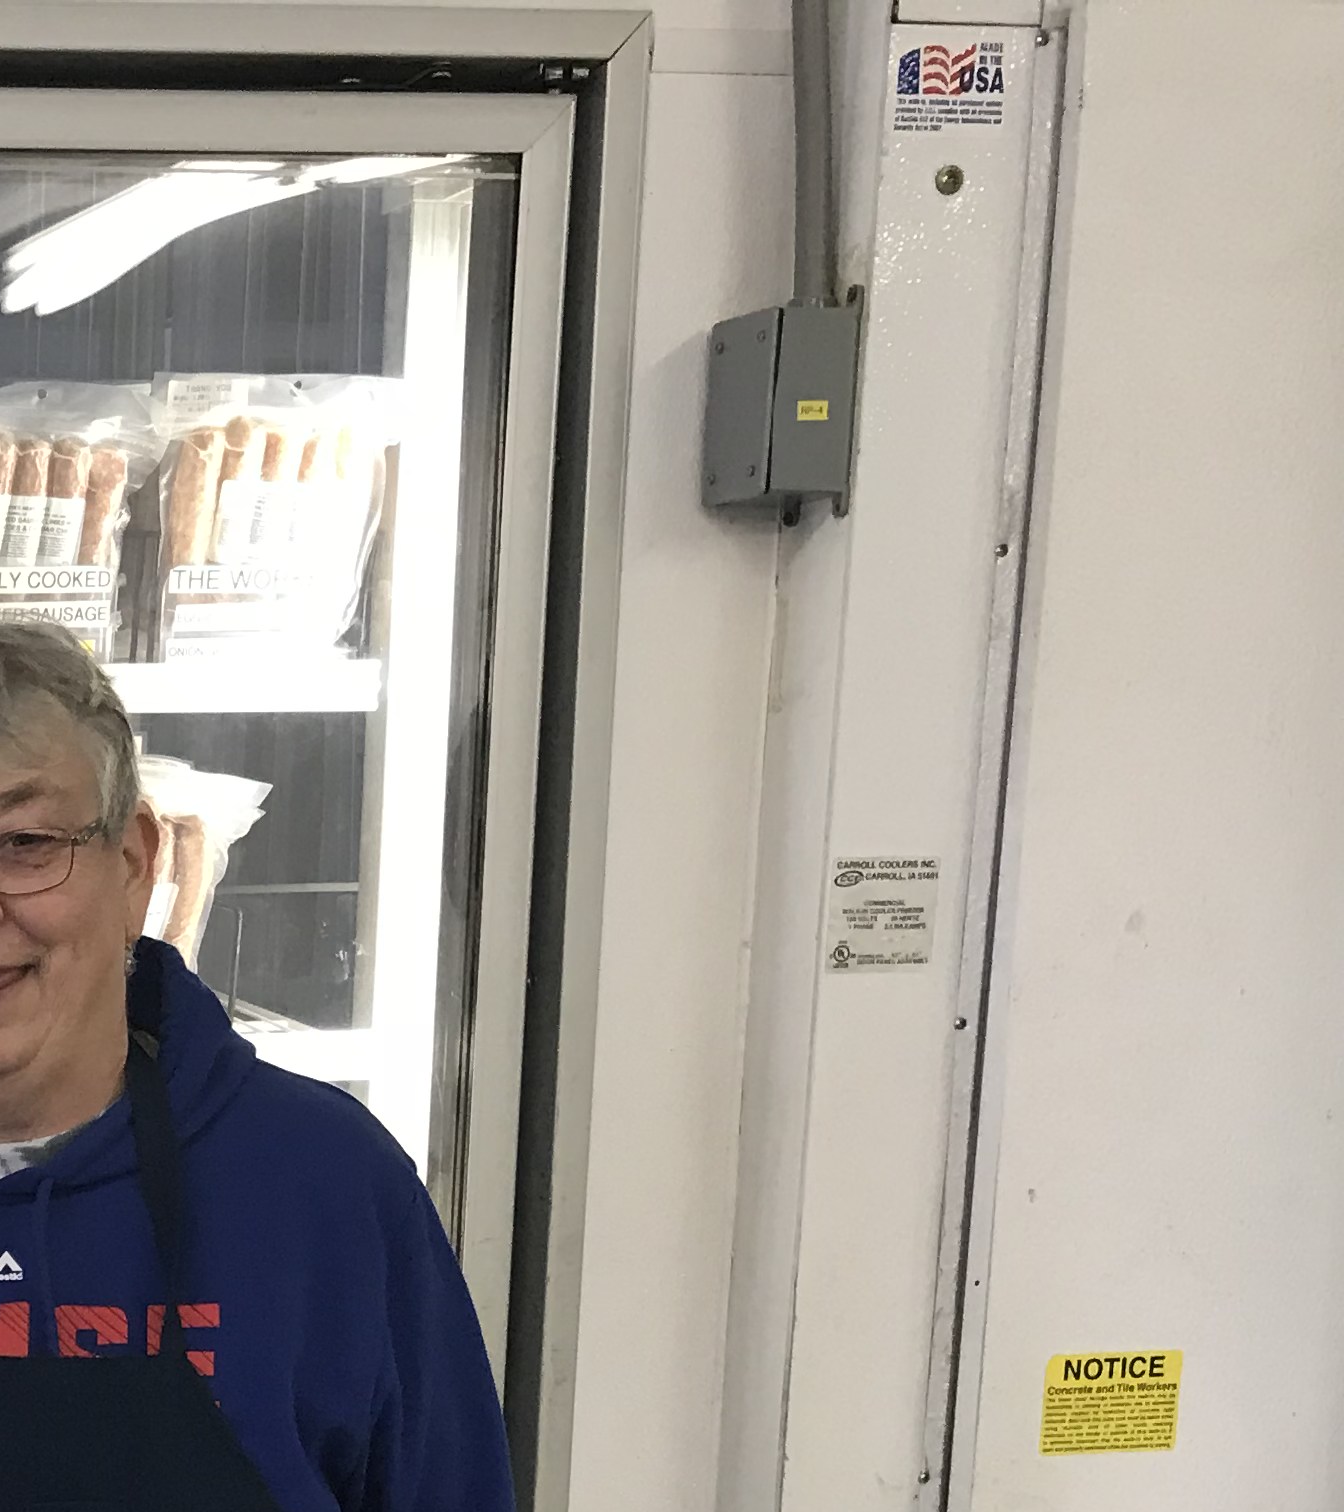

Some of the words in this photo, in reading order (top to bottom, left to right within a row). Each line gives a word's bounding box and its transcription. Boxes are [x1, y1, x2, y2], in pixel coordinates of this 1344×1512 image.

[960, 67, 1004, 94] USA
[27, 570, 111, 588] COOKED
[172, 570, 221, 590] THE
[30, 606, 108, 622] SAUSAGE
[837, 861, 876, 870] CARROLL
[878, 860, 919, 869] COOLERS
[908, 872, 916, 880] IA
[1063, 1356, 1166, 1380] NOTICE
[1047, 1386, 1093, 1396] Concrete
[1096, 1384, 1114, 1394] and
[1116, 1384, 1134, 1392] Tile
[1137, 1382, 1178, 1392] Workers
